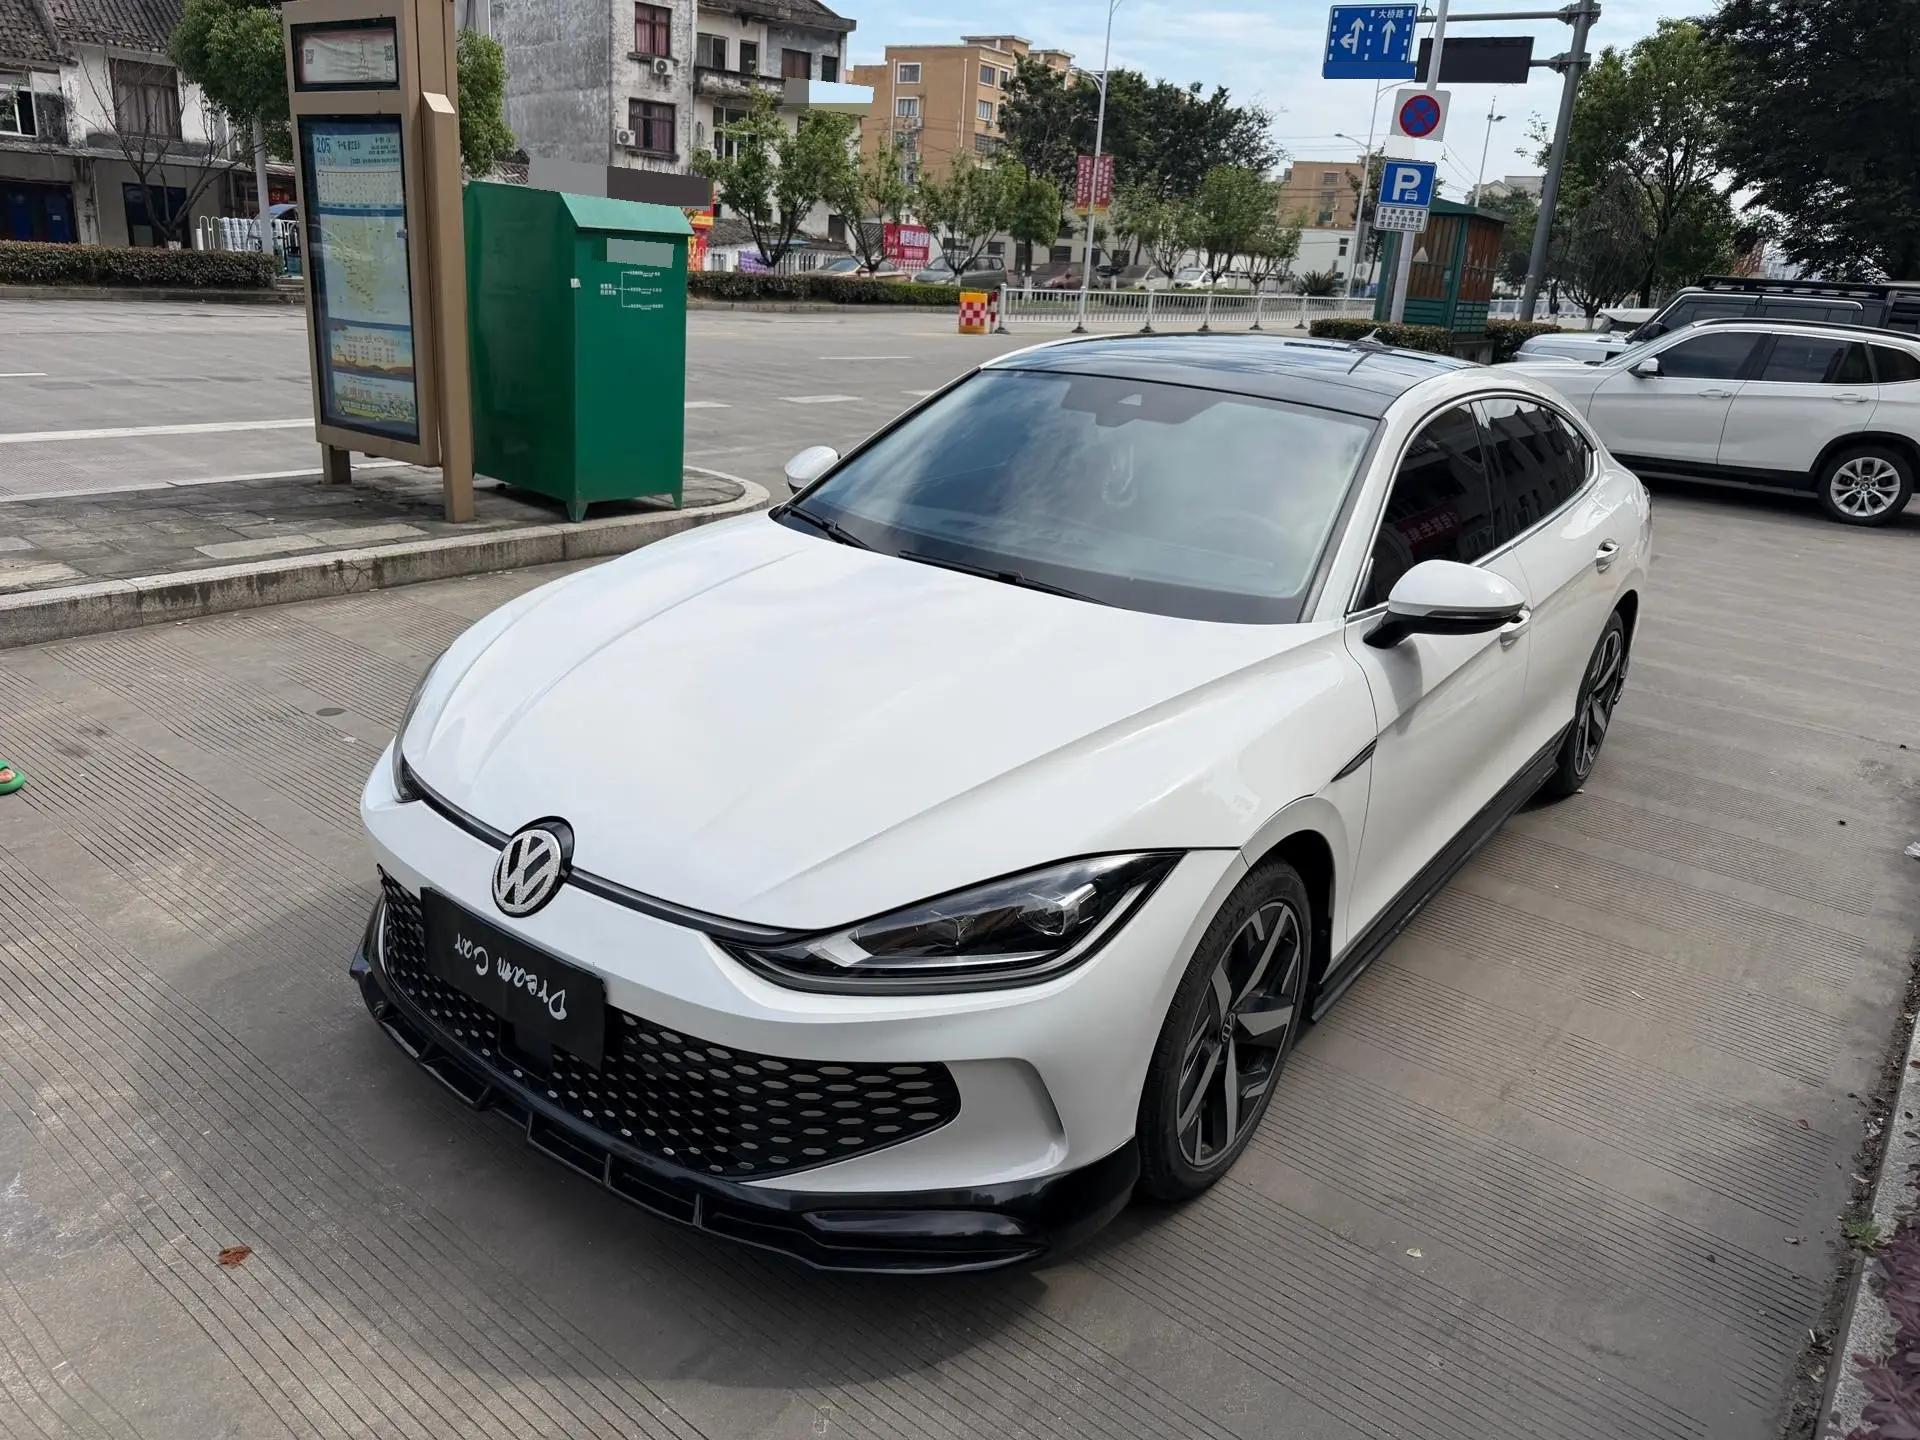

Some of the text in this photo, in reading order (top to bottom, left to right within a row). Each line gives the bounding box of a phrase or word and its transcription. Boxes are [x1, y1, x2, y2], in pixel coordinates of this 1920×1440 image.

[1378, 9, 1404, 19] 大桥路
[1392, 167, 1421, 200] P
[454, 933, 567, 1020] Dream Car
